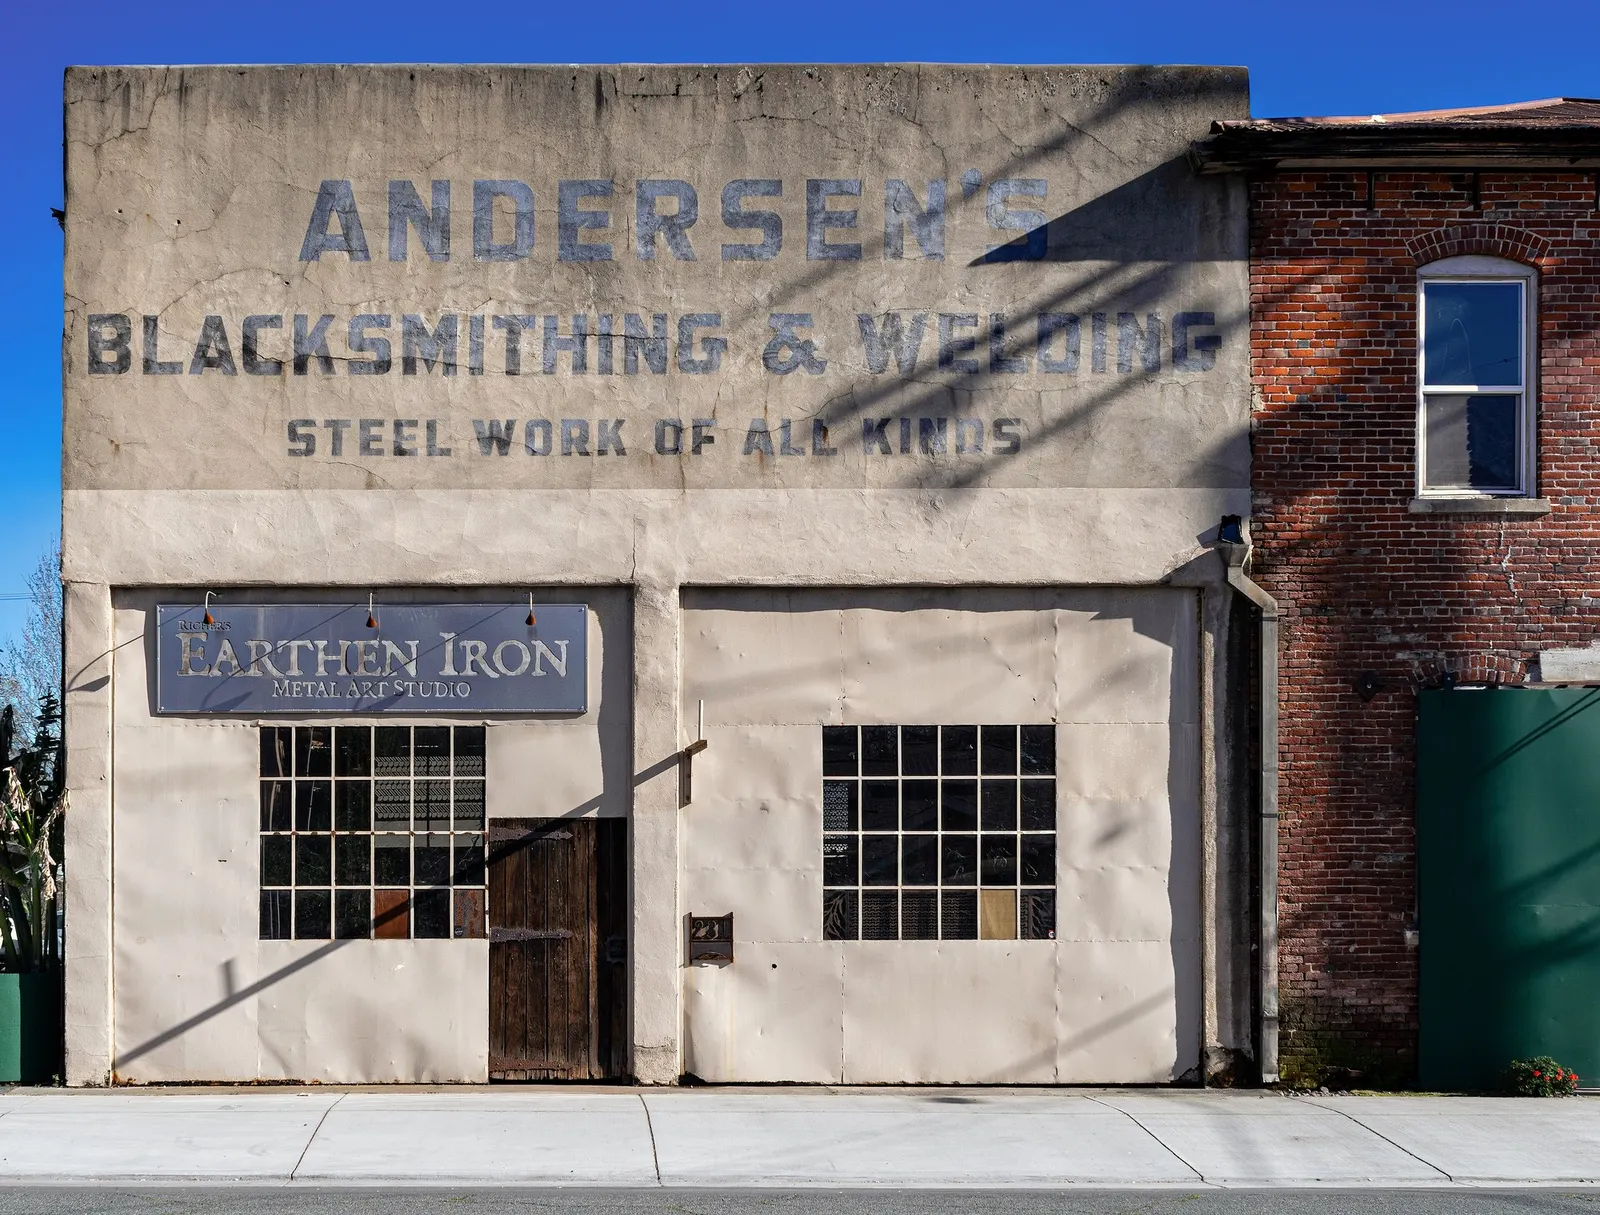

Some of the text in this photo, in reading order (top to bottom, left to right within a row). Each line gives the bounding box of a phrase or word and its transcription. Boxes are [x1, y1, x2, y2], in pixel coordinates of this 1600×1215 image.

[299, 169, 1048, 262] ANDERSEN'S
[87, 311, 1222, 375] BLACKSMITHING & WELDING
[287, 417, 1022, 457] STEEL WORK OF ALL KINDS
[176, 631, 570, 678] EARTHEN IRON
[272, 679, 472, 698] METAL ART STUDIO
